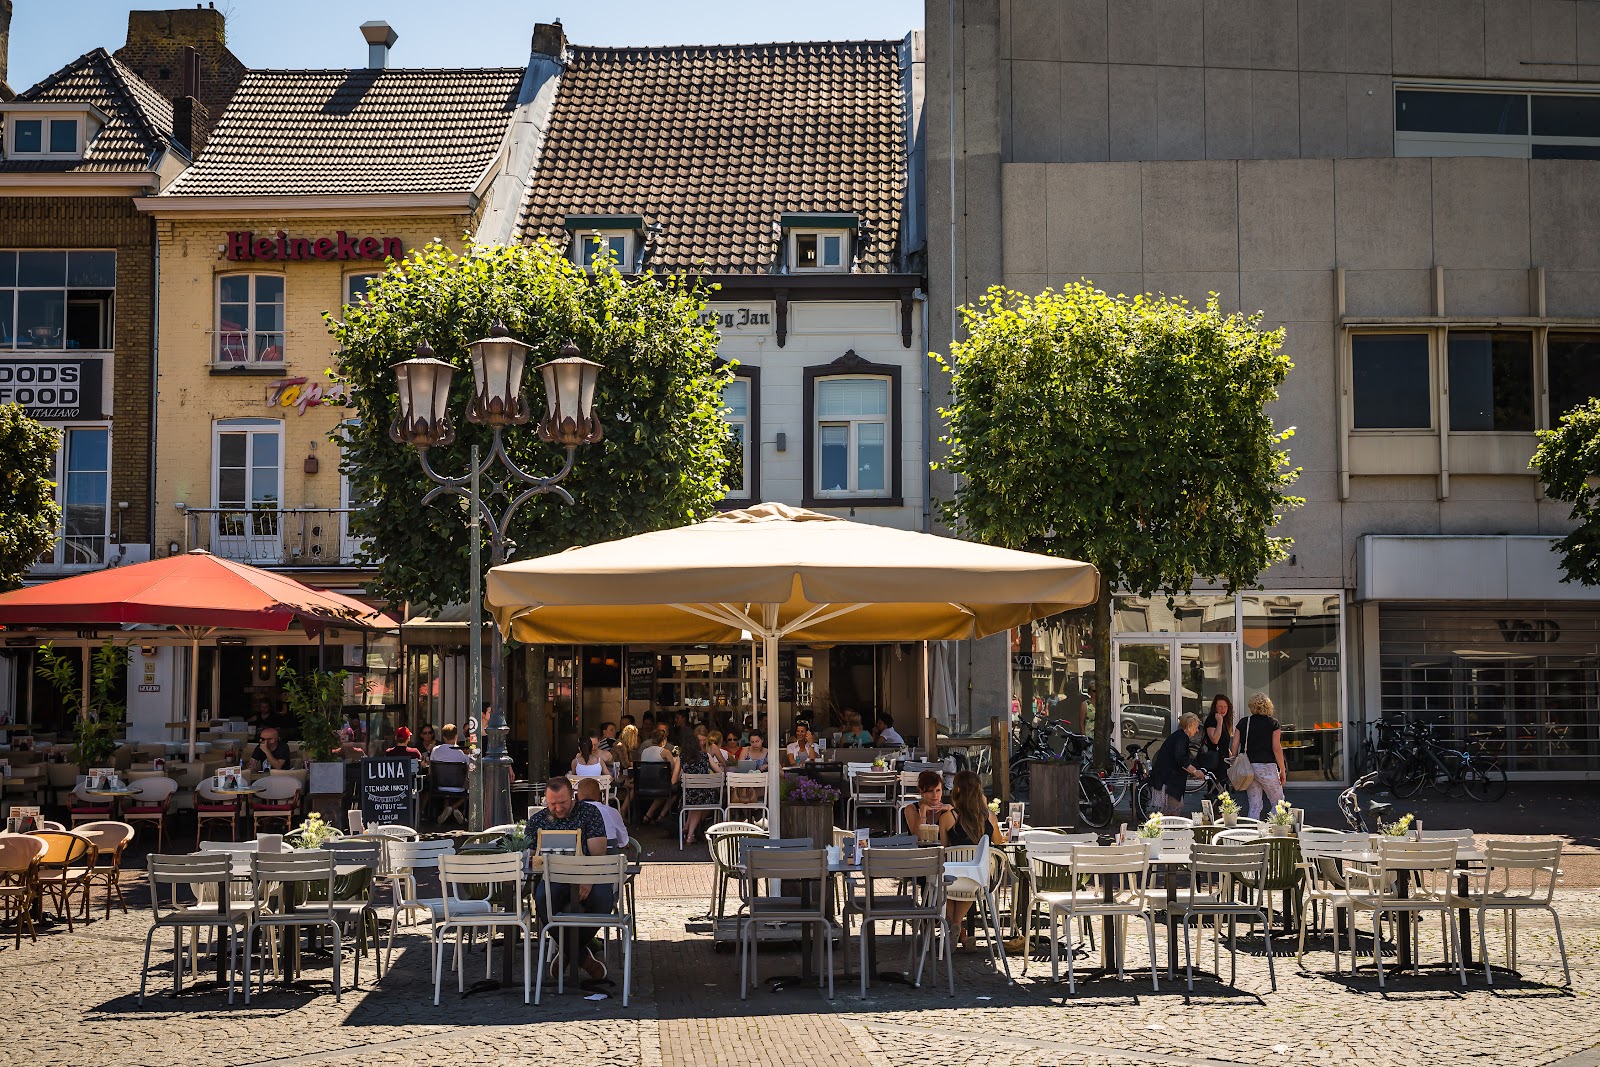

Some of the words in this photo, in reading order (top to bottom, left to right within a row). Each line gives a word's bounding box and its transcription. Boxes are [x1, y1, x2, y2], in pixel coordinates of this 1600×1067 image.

[227, 231, 403, 260] Heineken
[737, 308, 770, 330] Jan
[0, 389, 78, 404] FOOD
[30, 408, 79, 418] ITALIANO
[1308, 656, 1338, 666] VD.nl
[368, 761, 405, 779] LUNA
